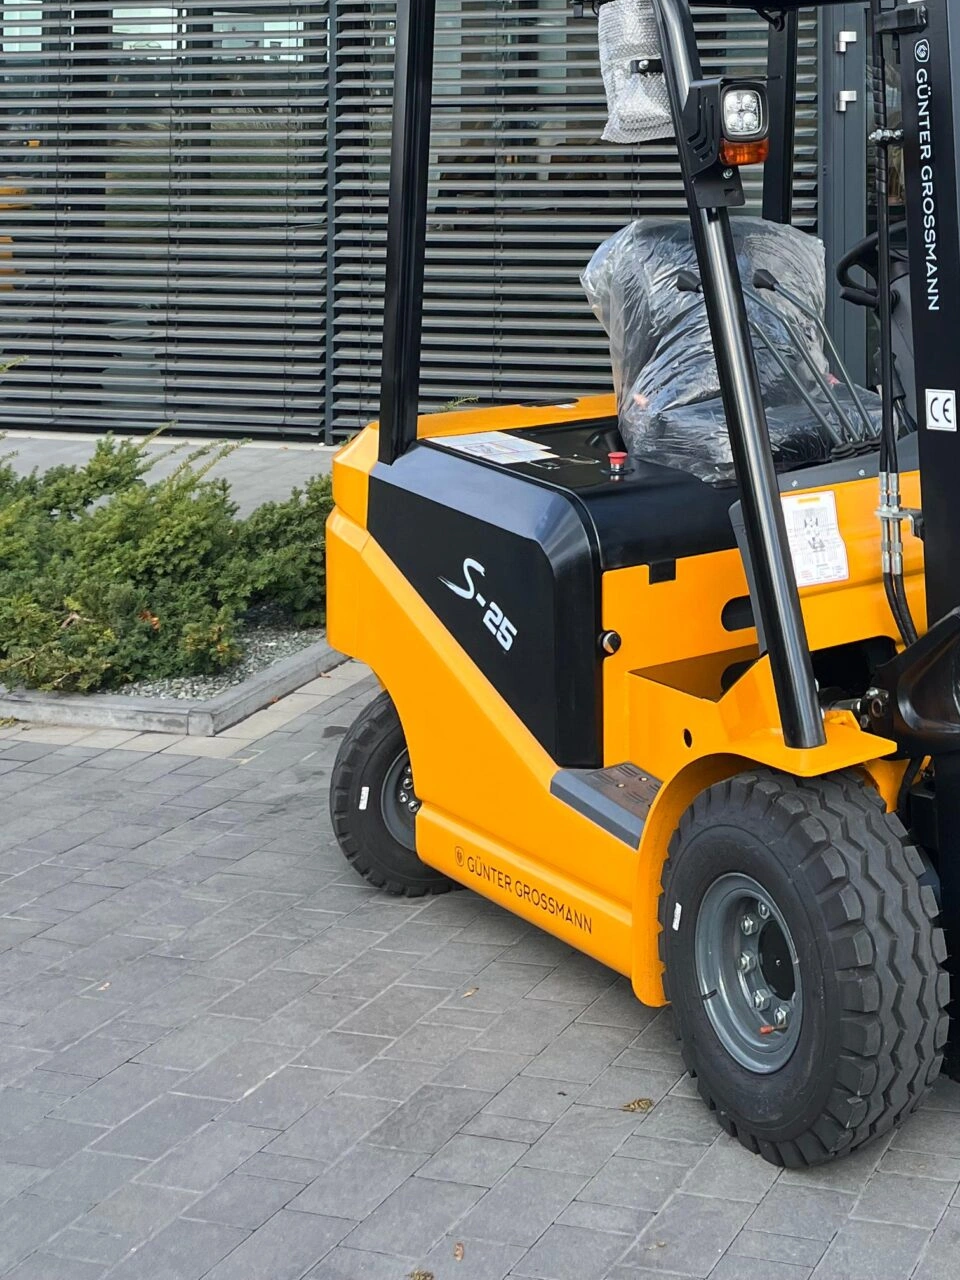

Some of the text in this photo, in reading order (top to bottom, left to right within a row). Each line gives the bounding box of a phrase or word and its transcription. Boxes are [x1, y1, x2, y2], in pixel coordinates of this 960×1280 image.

[916, 68, 940, 311] GÜNTER GROSSMANN
[930, 396, 952, 423] CE
[437, 558, 518, 651] S-25
[467, 856, 592, 934] GÜNTER GROSSMANN
